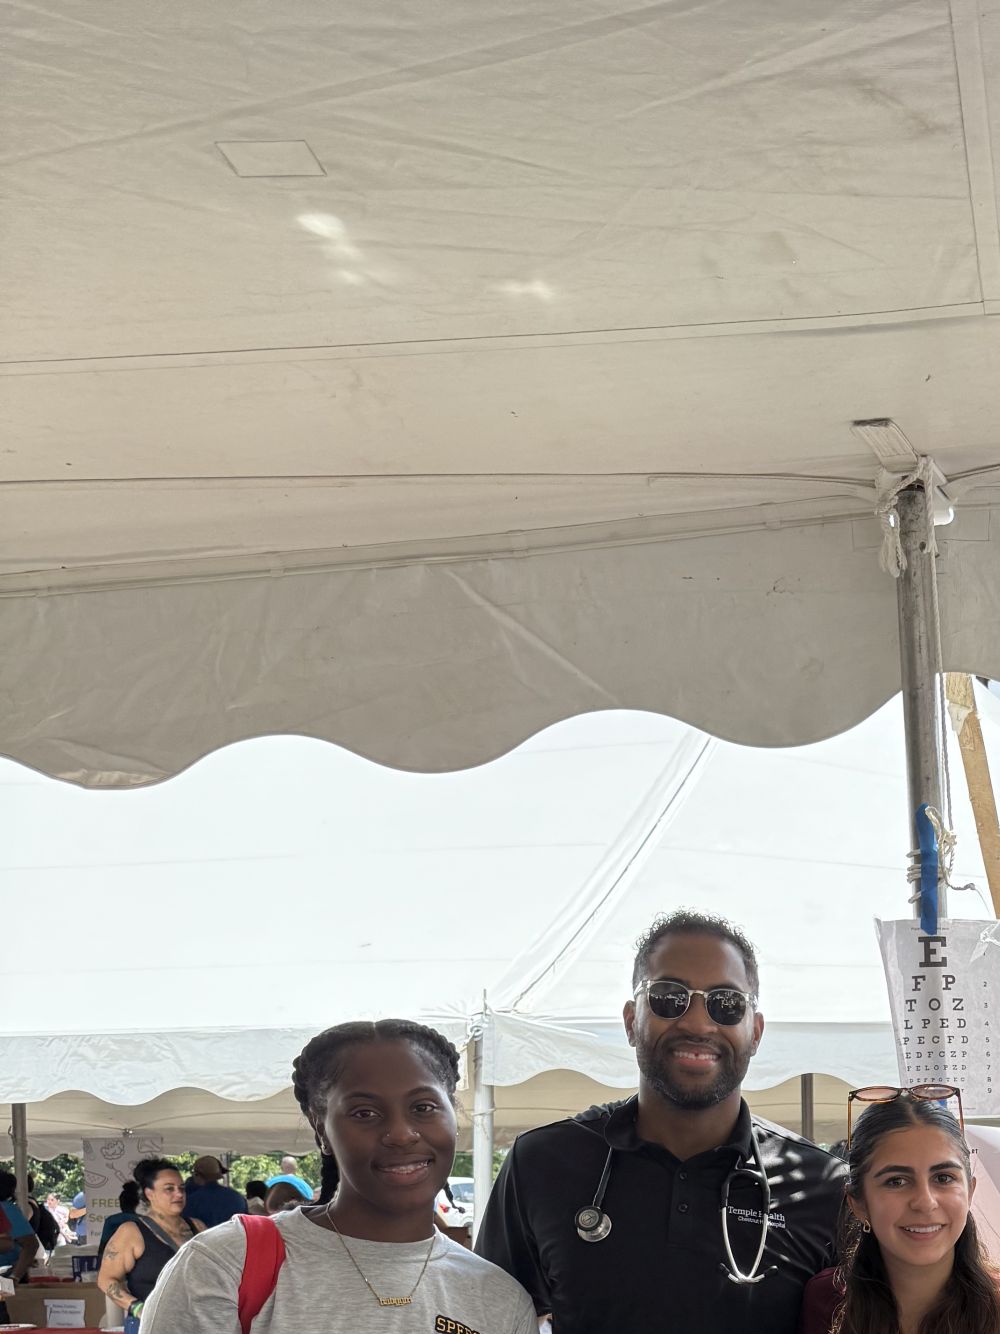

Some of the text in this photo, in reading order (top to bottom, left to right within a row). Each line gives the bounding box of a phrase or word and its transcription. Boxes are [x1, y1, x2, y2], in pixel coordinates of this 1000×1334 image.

[918, 936, 947, 968] E
[728, 1206, 785, 1222] Temple Halth
